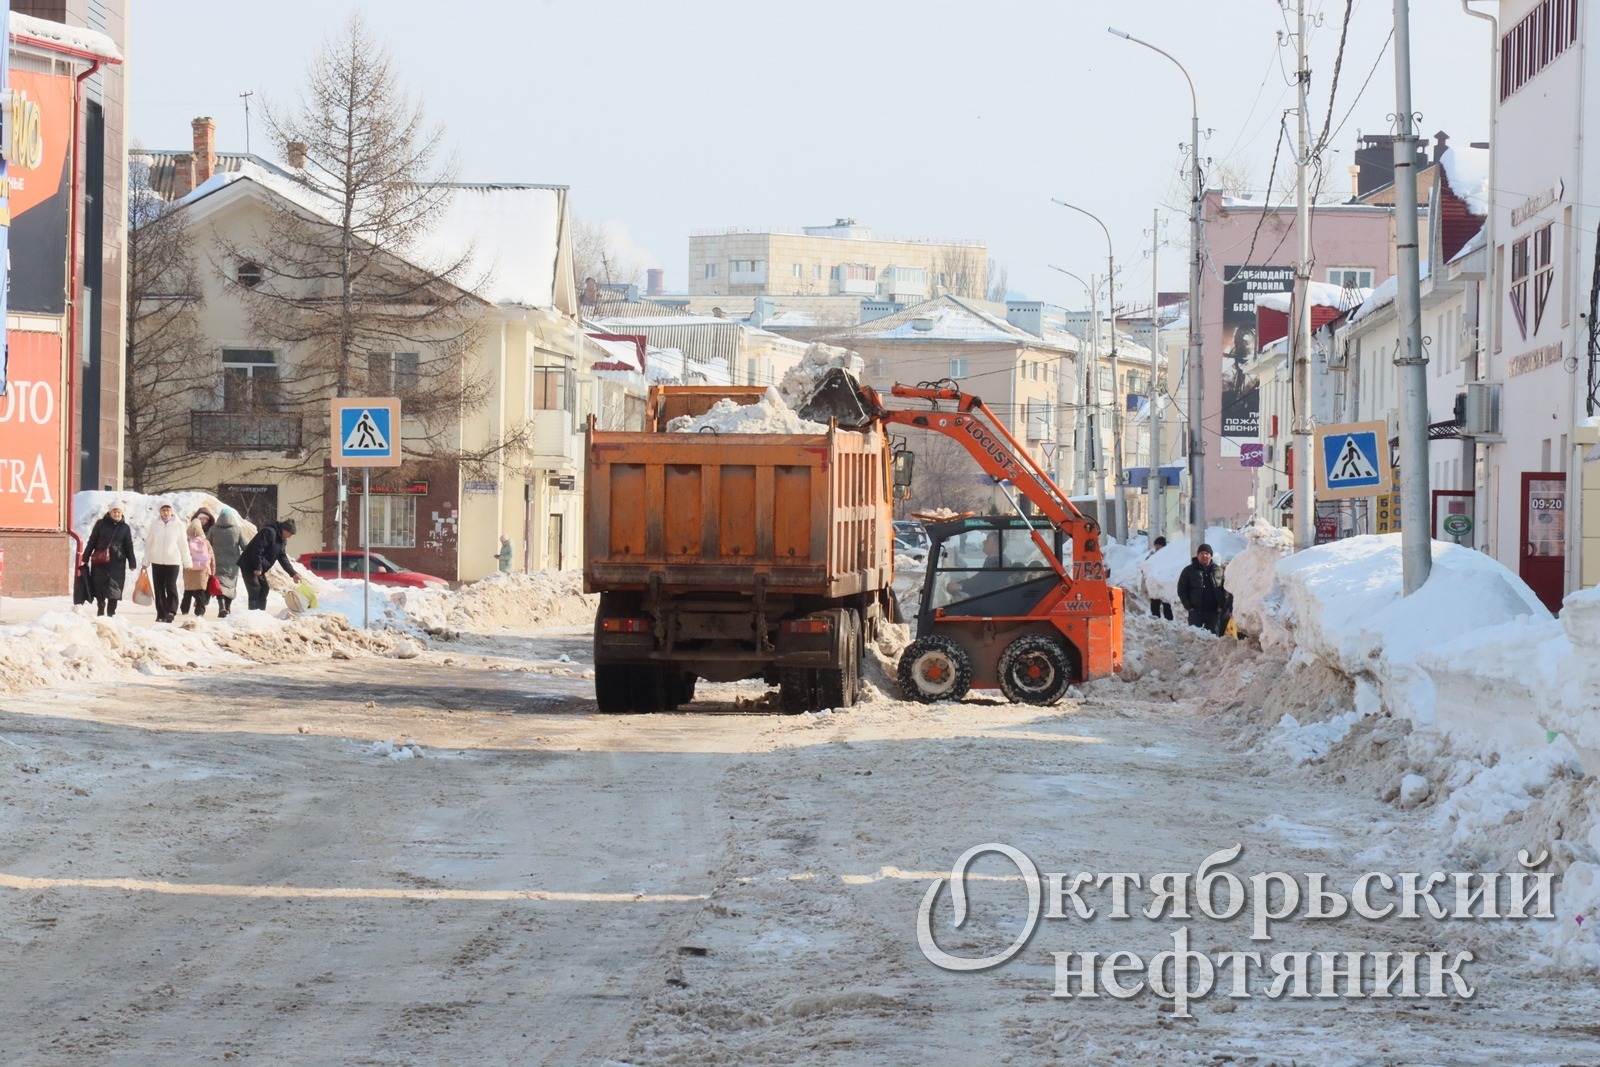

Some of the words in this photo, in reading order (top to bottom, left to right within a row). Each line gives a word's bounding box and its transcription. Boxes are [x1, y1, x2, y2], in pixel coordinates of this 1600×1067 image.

[1246, 281, 1285, 290] ПРАВИЛА
[965, 421, 1014, 469] LOCUST
[1532, 499, 1562, 509] 09-20
[1073, 562, 1103, 580] 752
